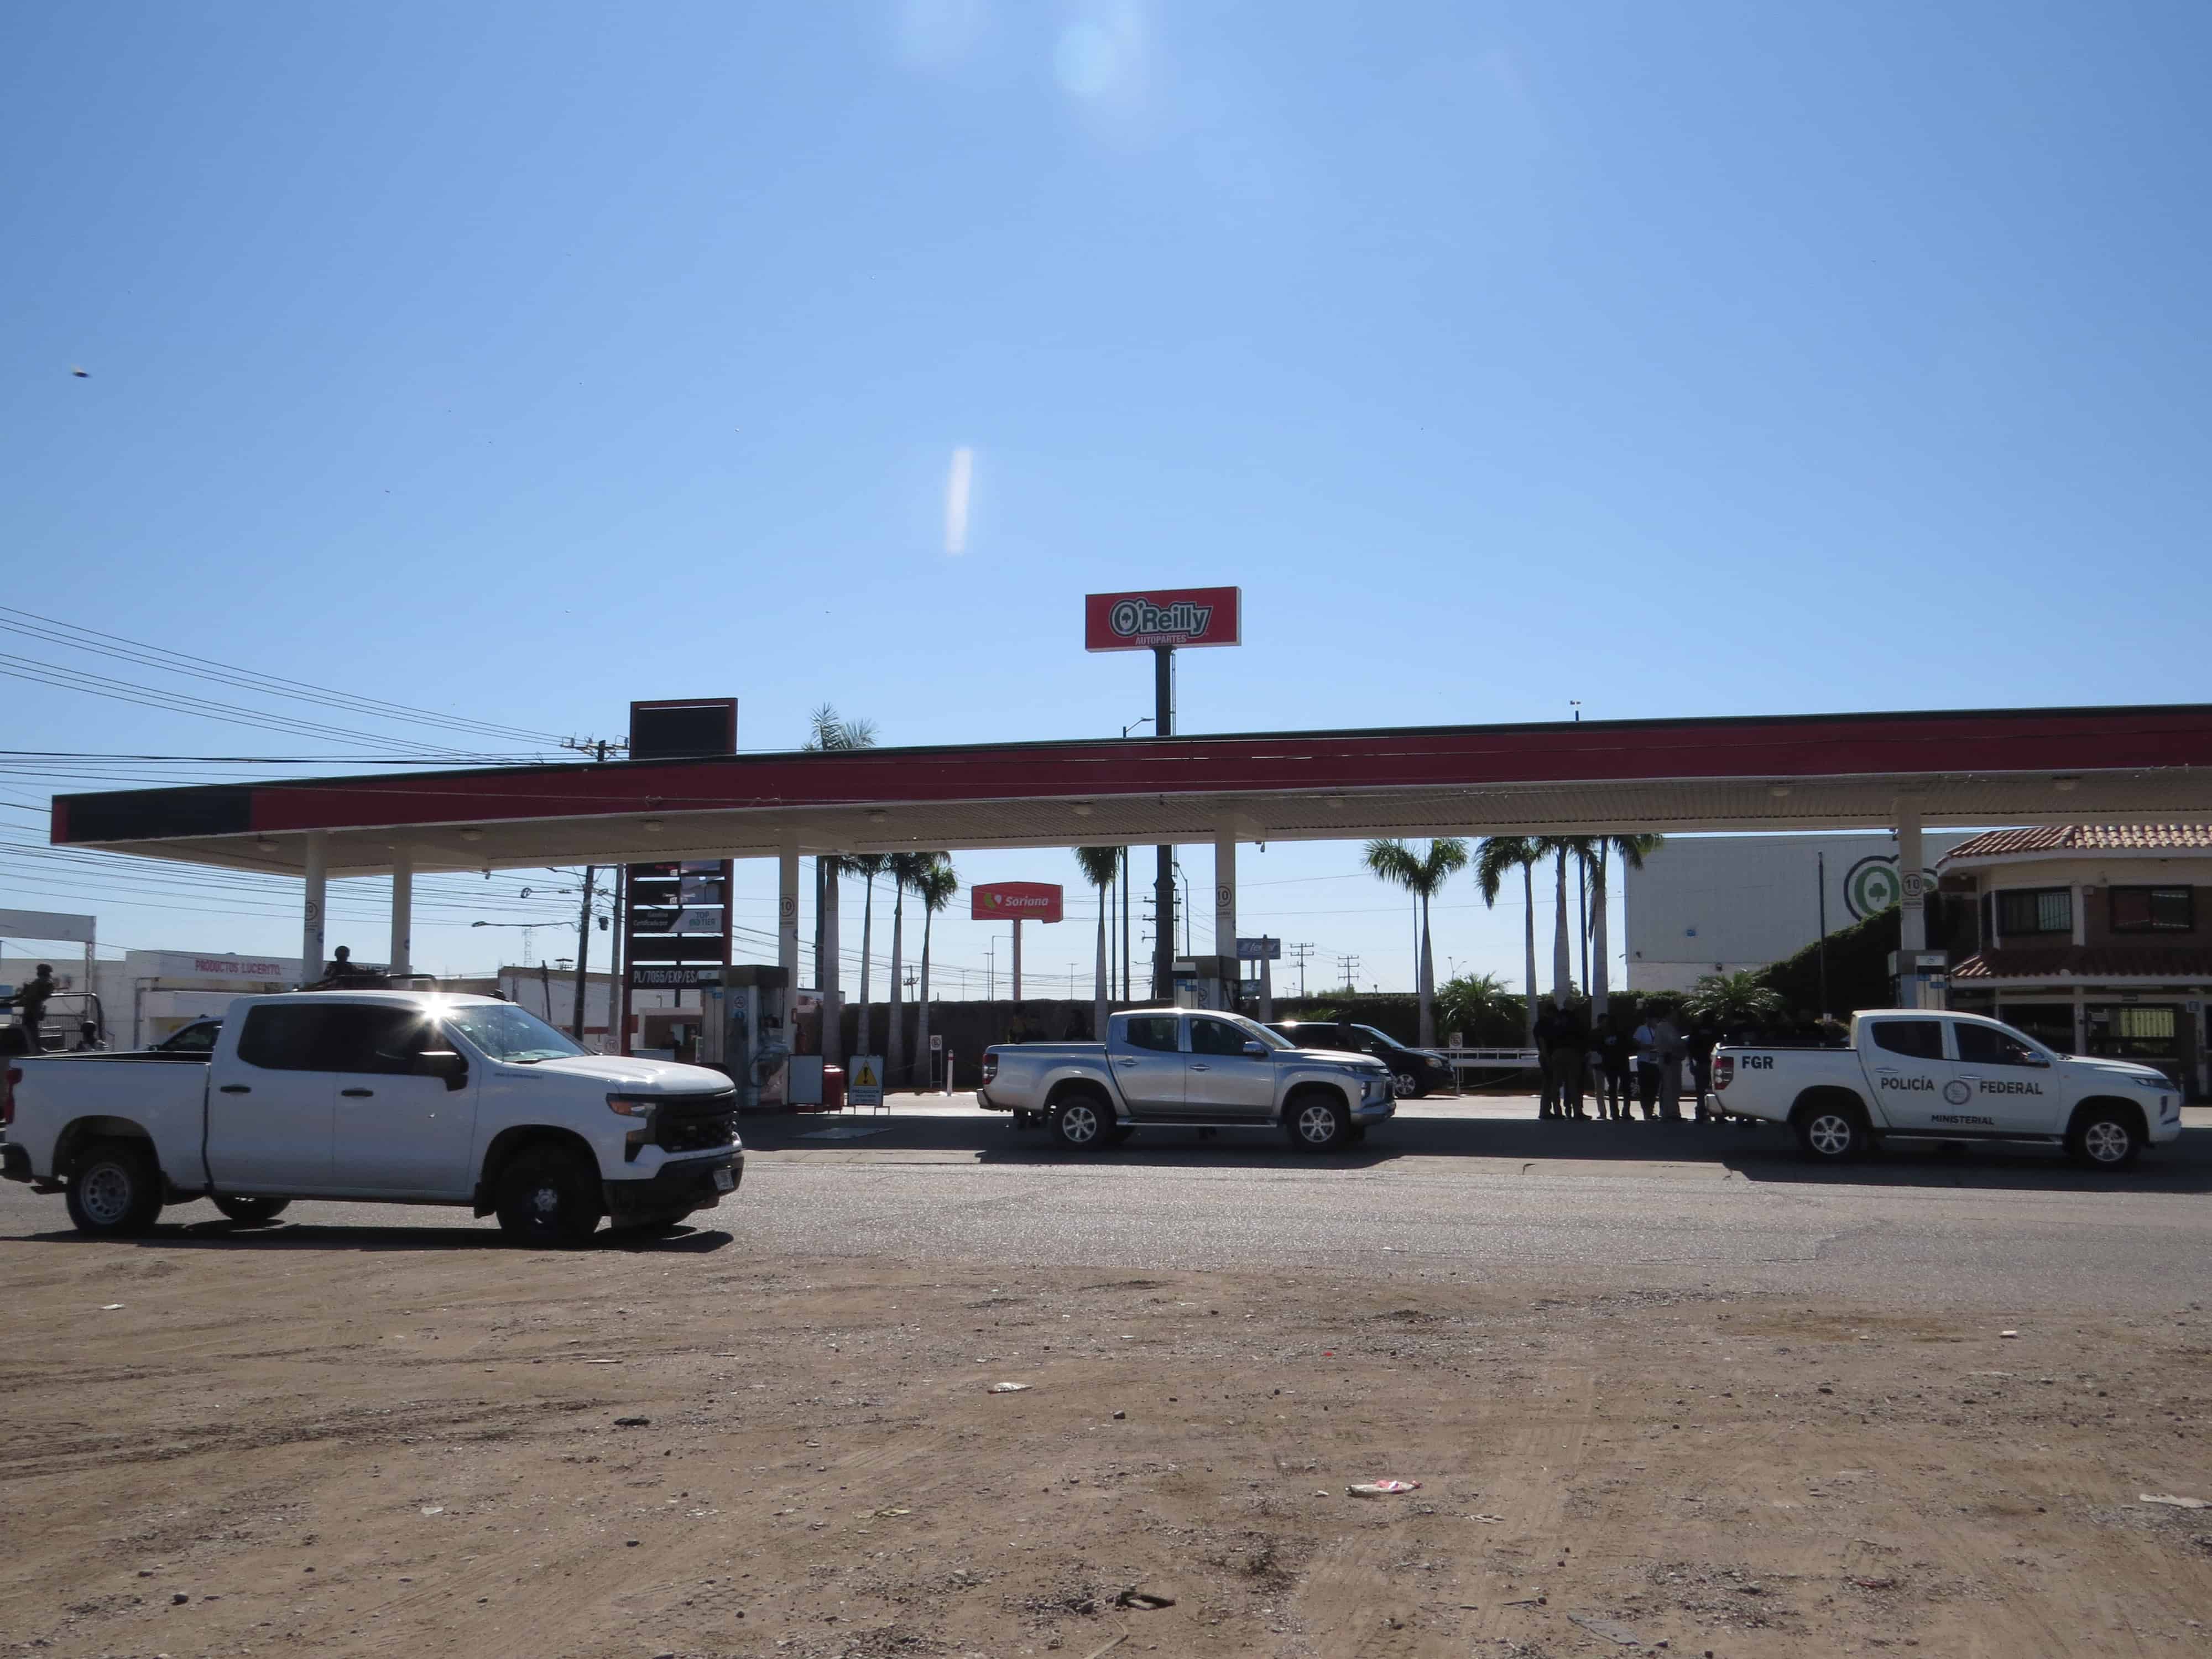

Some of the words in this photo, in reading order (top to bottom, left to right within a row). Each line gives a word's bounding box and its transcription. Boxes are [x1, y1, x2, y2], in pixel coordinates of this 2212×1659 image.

[1111, 598, 1212, 637] O'Reilly
[1135, 635, 1187, 645] AUTOPARTES
[1907, 879, 1920, 890] 10
[1005, 895, 1049, 907] Soriana
[1218, 890, 1229, 901] 10
[195, 959, 239, 973] PRODUCTOS
[1741, 1056, 1773, 1070] FGR
[1881, 1076, 1934, 1092] POLICÍA
[1979, 1080, 2043, 1096] FEDERAL
[1931, 1114, 1995, 1126] MINISTERIAL
